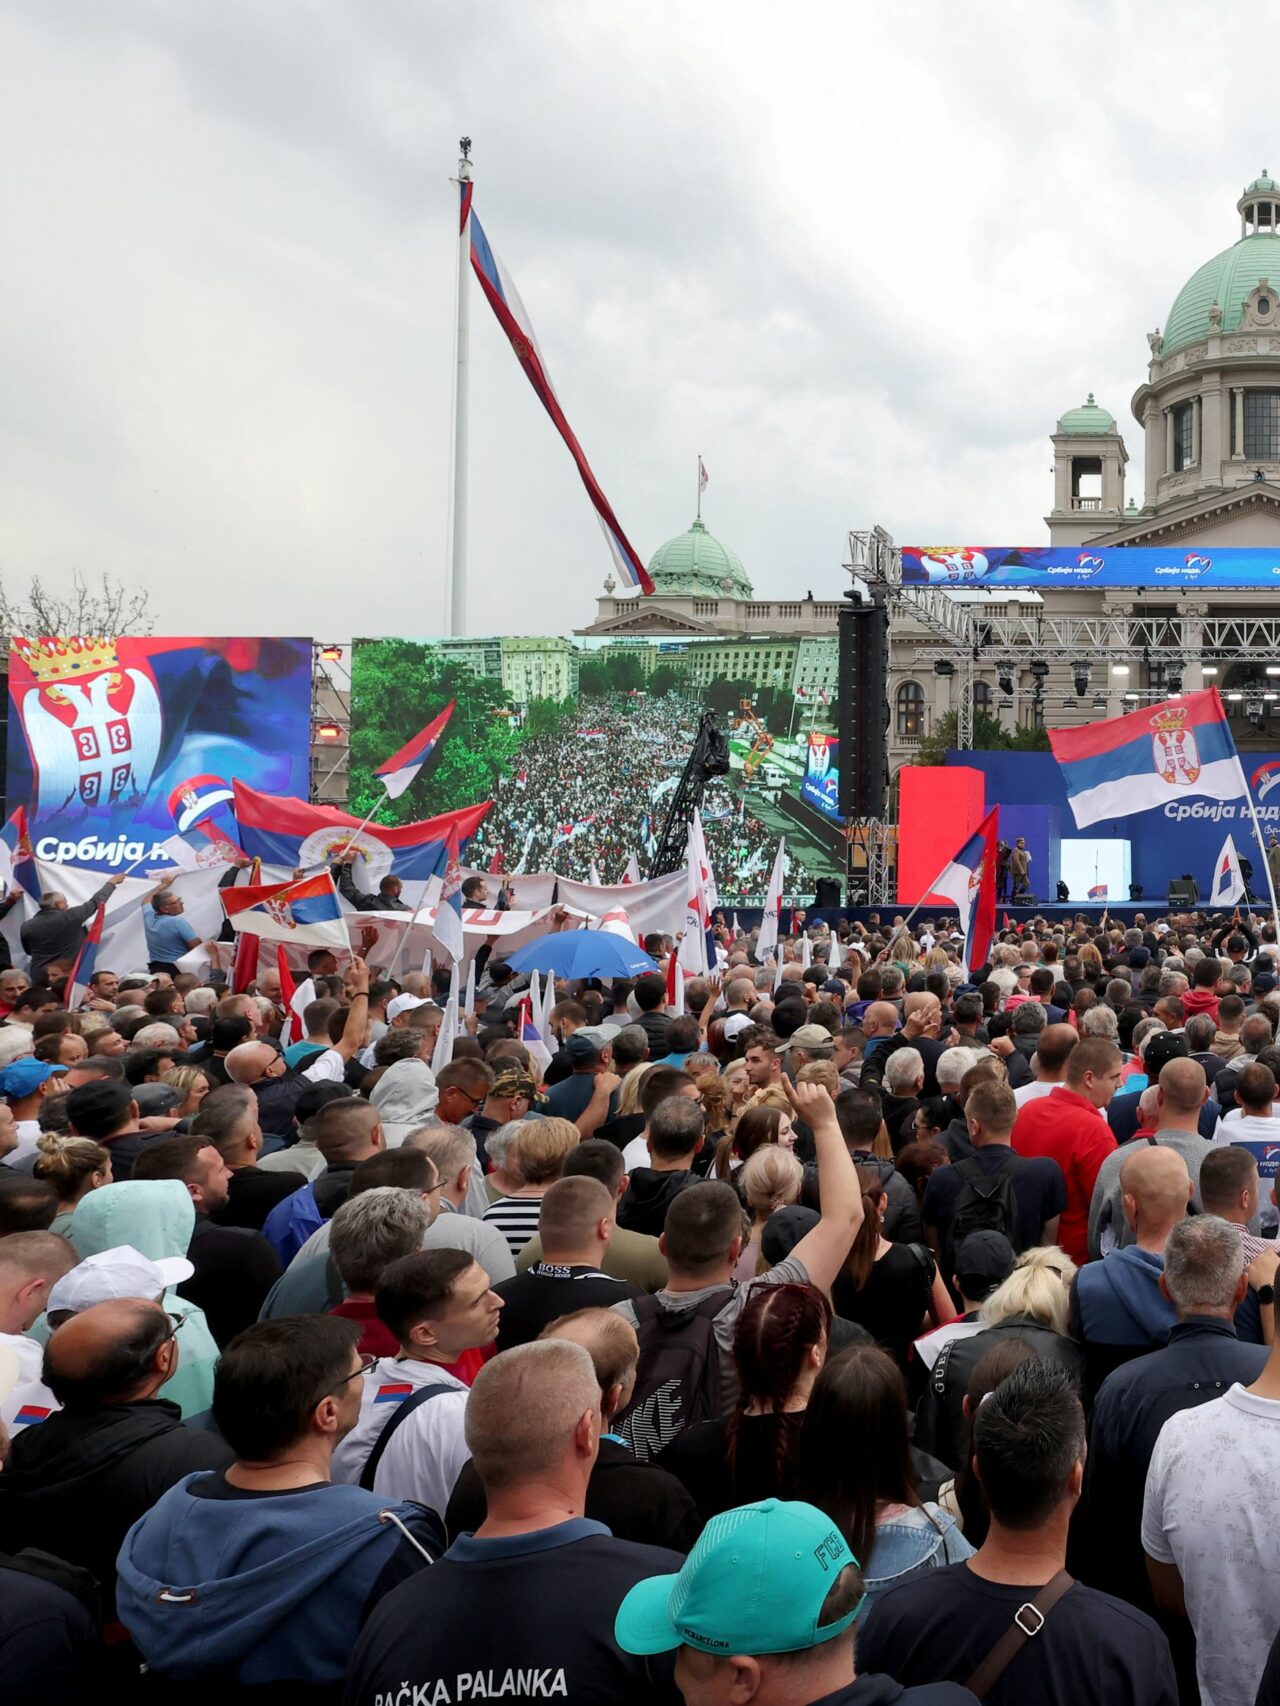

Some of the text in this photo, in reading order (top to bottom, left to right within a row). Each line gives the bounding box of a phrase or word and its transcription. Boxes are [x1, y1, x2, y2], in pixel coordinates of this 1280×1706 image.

[1047, 566, 1072, 575] Србија
[1155, 566, 1180, 575] Србија
[1164, 801, 1236, 821] Србија
[36, 834, 145, 866] Србија
[539, 1263, 572, 1274] BOSS
[813, 1531, 845, 1571] FCB
[456, 1668, 568, 1702] PALANKA
